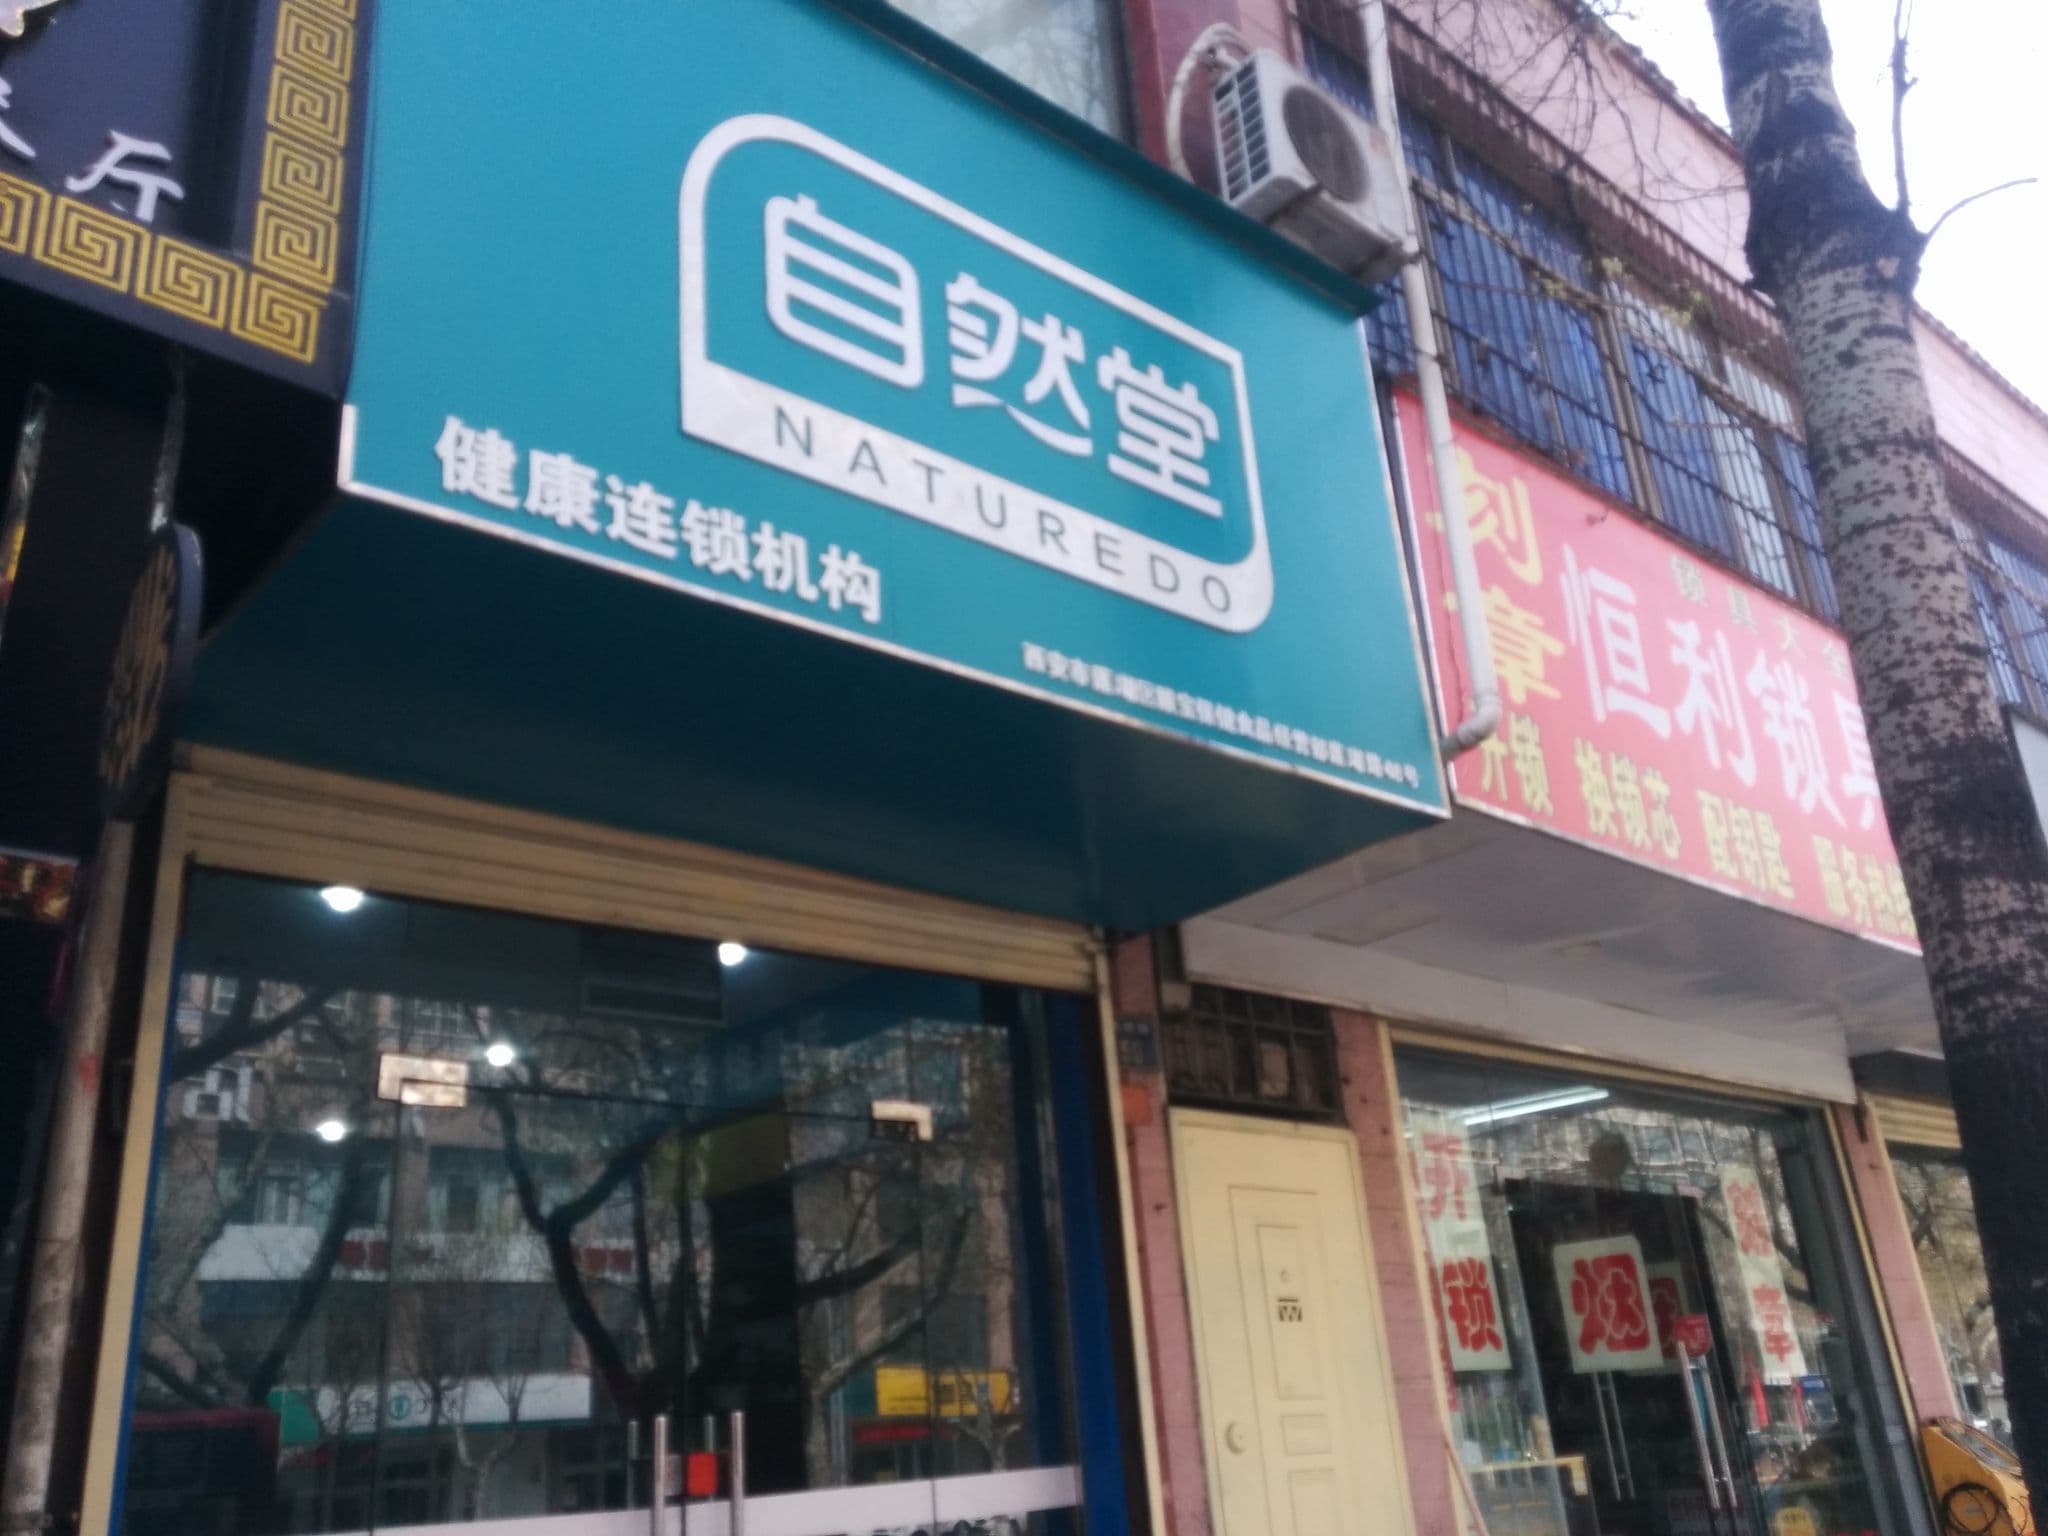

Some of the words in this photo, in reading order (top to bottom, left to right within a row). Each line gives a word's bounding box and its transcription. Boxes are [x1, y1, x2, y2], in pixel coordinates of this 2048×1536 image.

[765, 193, 1222, 518] 自然堂
[433, 415, 882, 624] 健康连锁机构
[774, 404, 1232, 615] NATUREDO
[1421, 1130, 1503, 1352] 开锁
[1571, 1252, 1650, 1354] 烟
